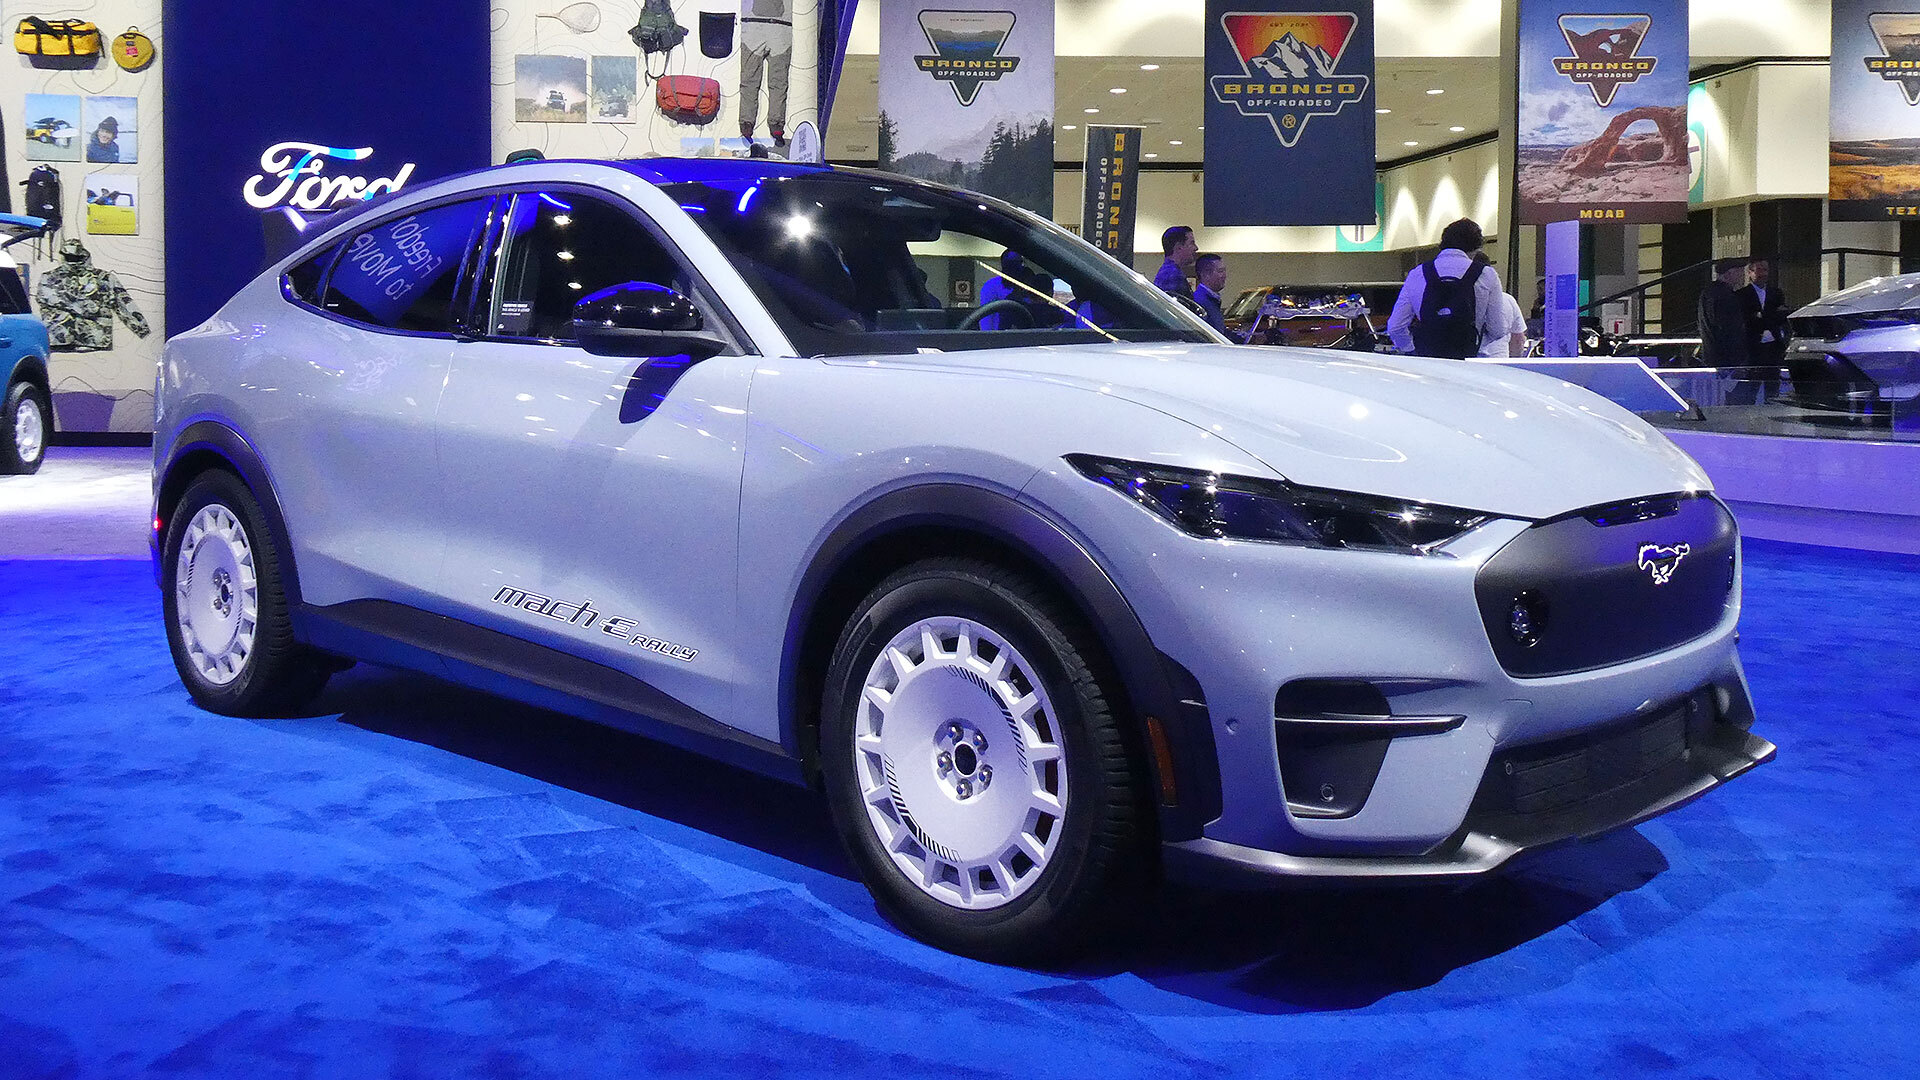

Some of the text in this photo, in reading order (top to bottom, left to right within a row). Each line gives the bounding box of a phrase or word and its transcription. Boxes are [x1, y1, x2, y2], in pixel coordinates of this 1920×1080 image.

[921, 59, 1013, 68] BRONCO
[1561, 62, 1649, 70] BRONCO
[1224, 83, 1355, 94] BRONCO
[1247, 99, 1332, 107] OFF-ROADEO
[243, 141, 416, 210] Ford
[1107, 133, 1126, 257] BRONC
[1095, 157, 1108, 248] OFF-ROADEO
[1580, 209, 1625, 219] MOAB
[1885, 206, 1920, 216] TEX
[629, 633, 700, 662] RALLY
